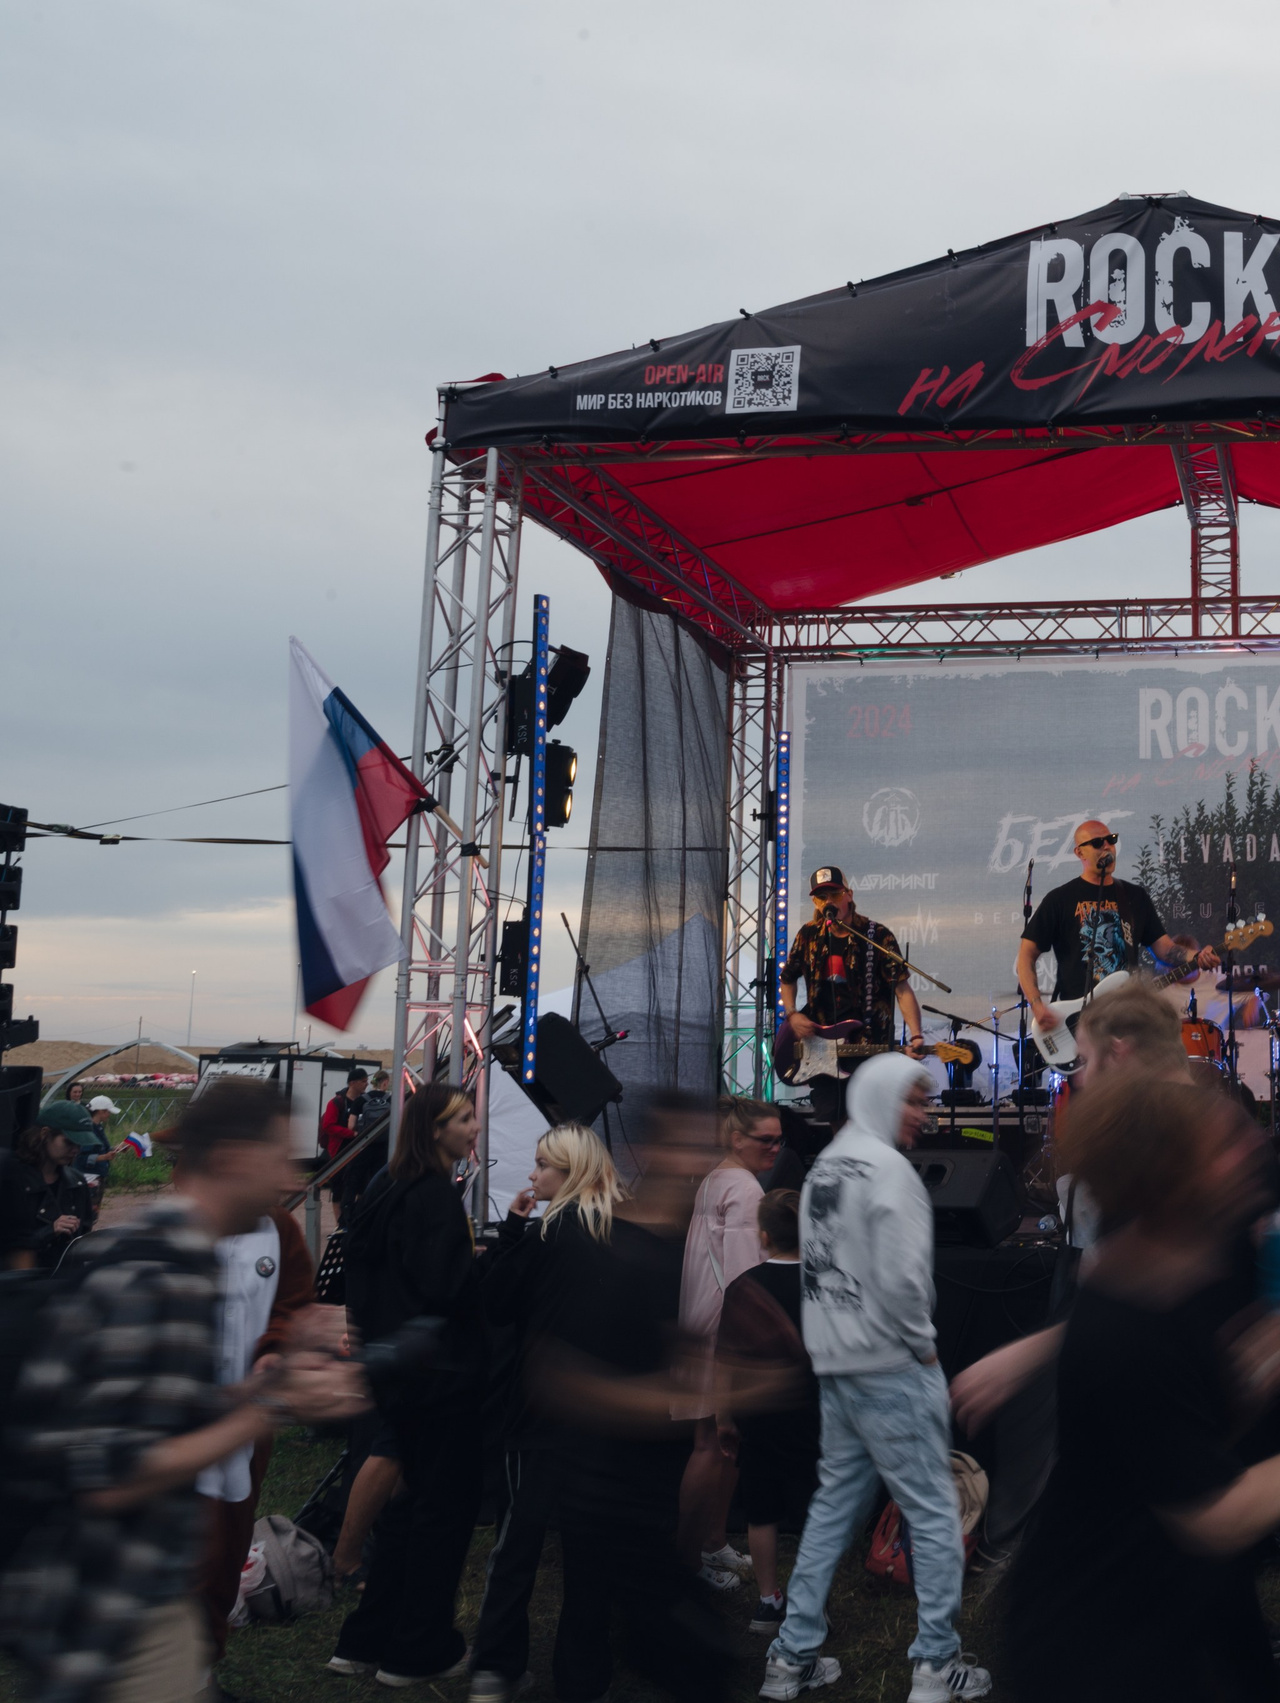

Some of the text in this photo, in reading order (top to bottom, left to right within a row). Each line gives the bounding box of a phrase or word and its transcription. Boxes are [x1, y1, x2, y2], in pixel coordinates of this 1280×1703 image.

[644, 364, 725, 385] OPEN-AIR
[897, 361, 986, 416] на
[576, 390, 722, 411] МИР БЕЗ НАРКОТИКОВ
[847, 703, 914, 738] 2024
